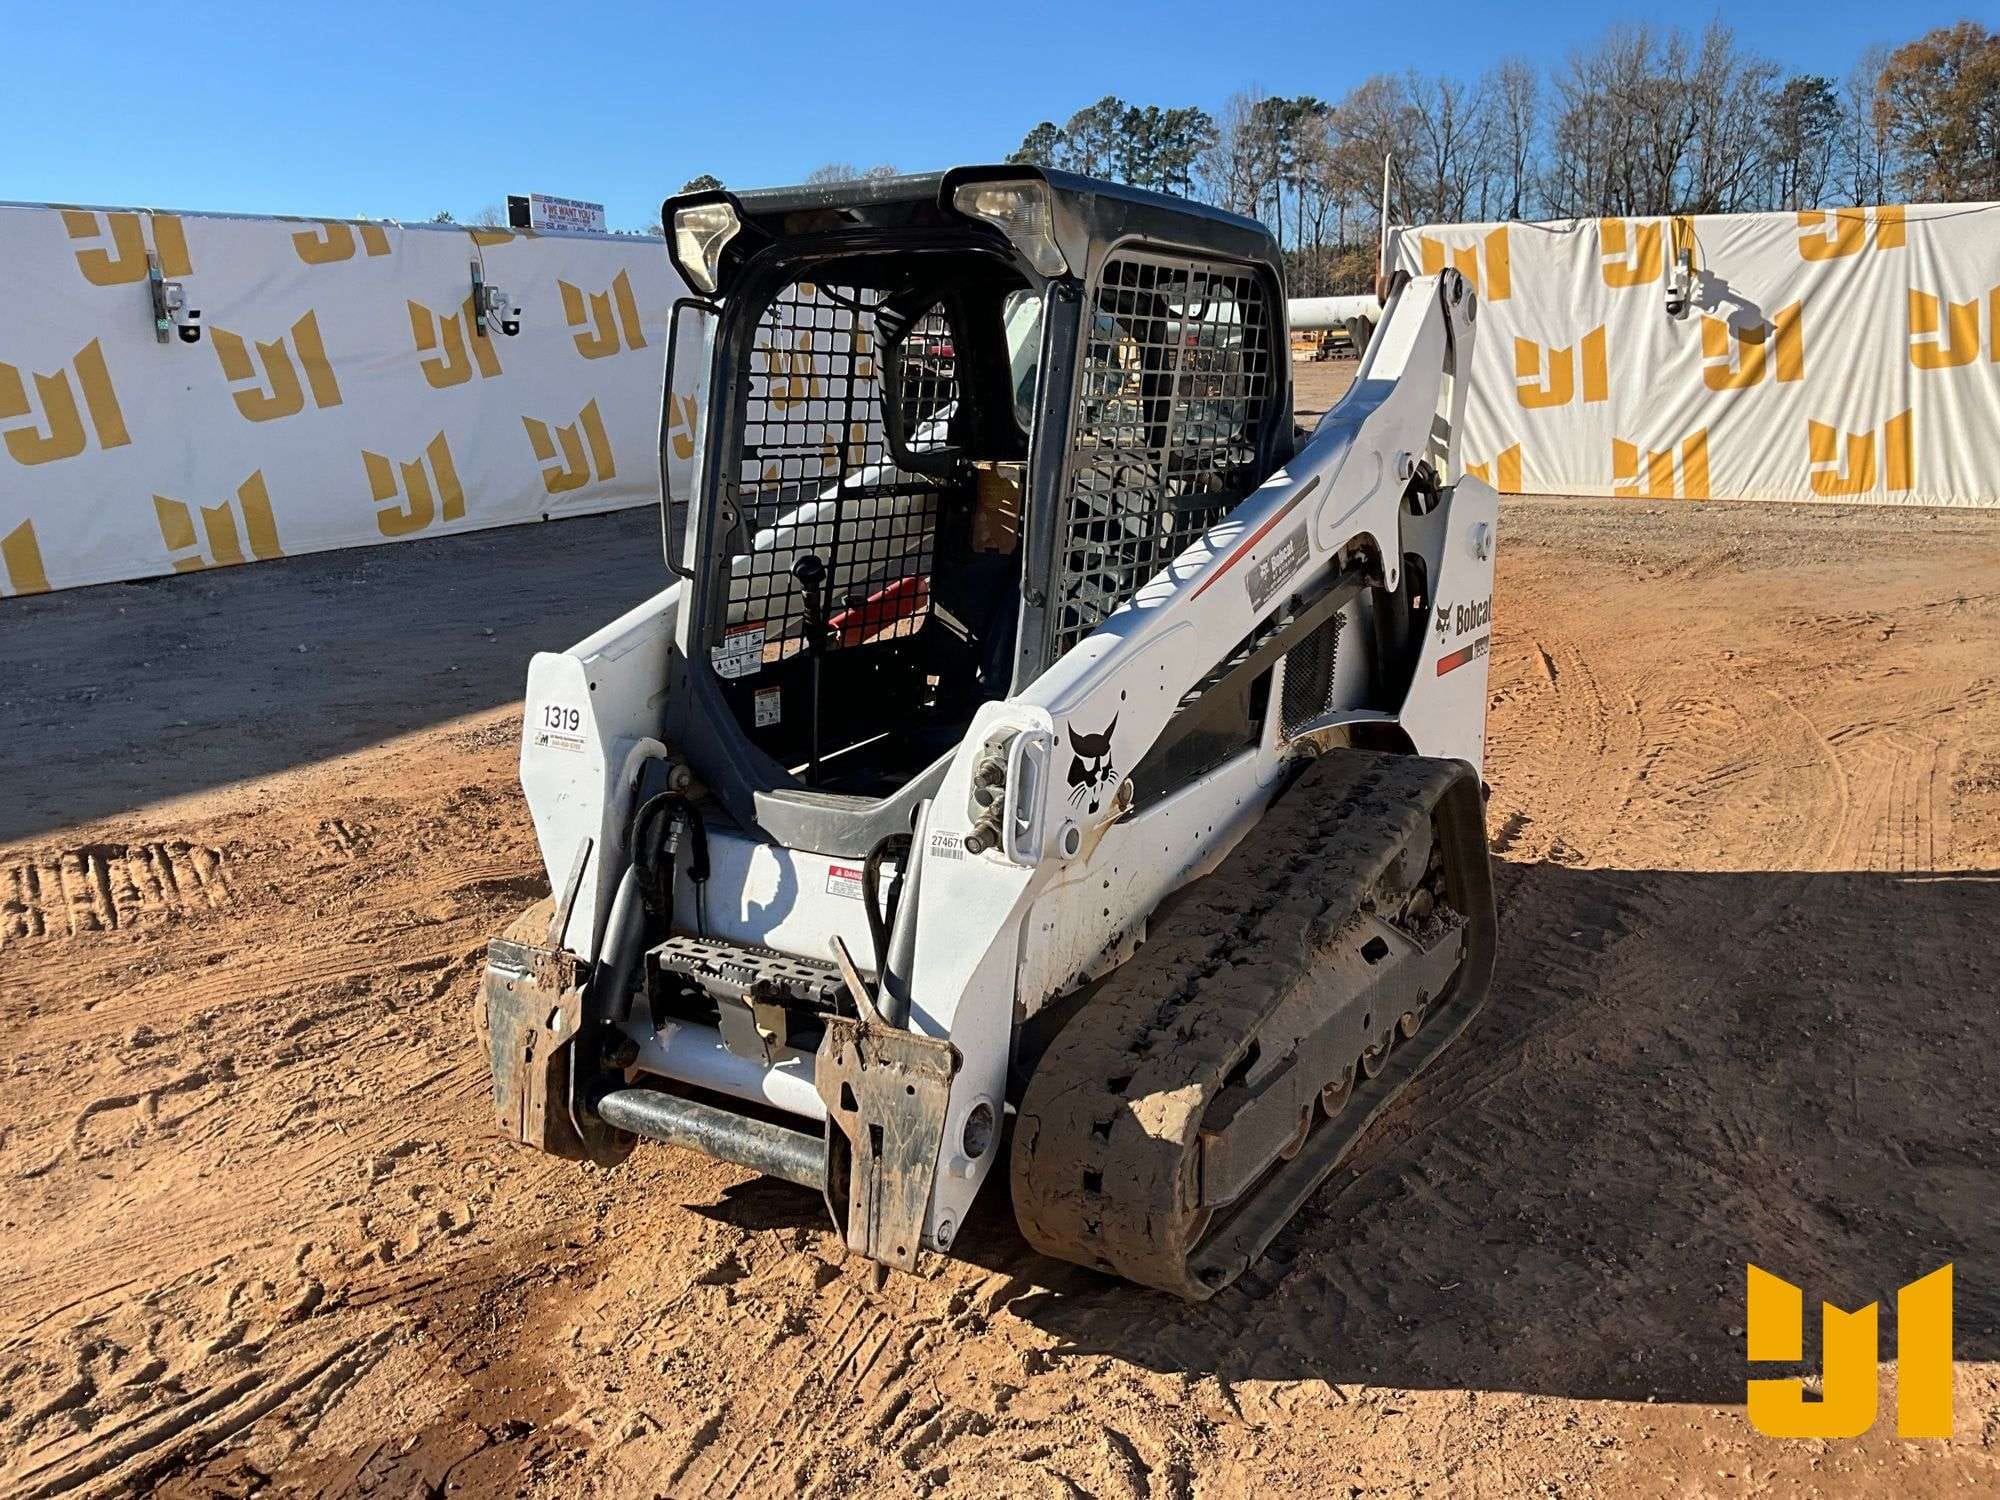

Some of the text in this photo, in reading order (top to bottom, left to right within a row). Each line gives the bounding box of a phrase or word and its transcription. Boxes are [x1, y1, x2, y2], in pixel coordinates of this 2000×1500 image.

[548, 204, 558, 214] WE
[559, 205, 577, 217] WANT
[544, 705, 580, 731] 1319
[932, 835, 963, 849] 274671
[843, 870, 864, 881] DANG
